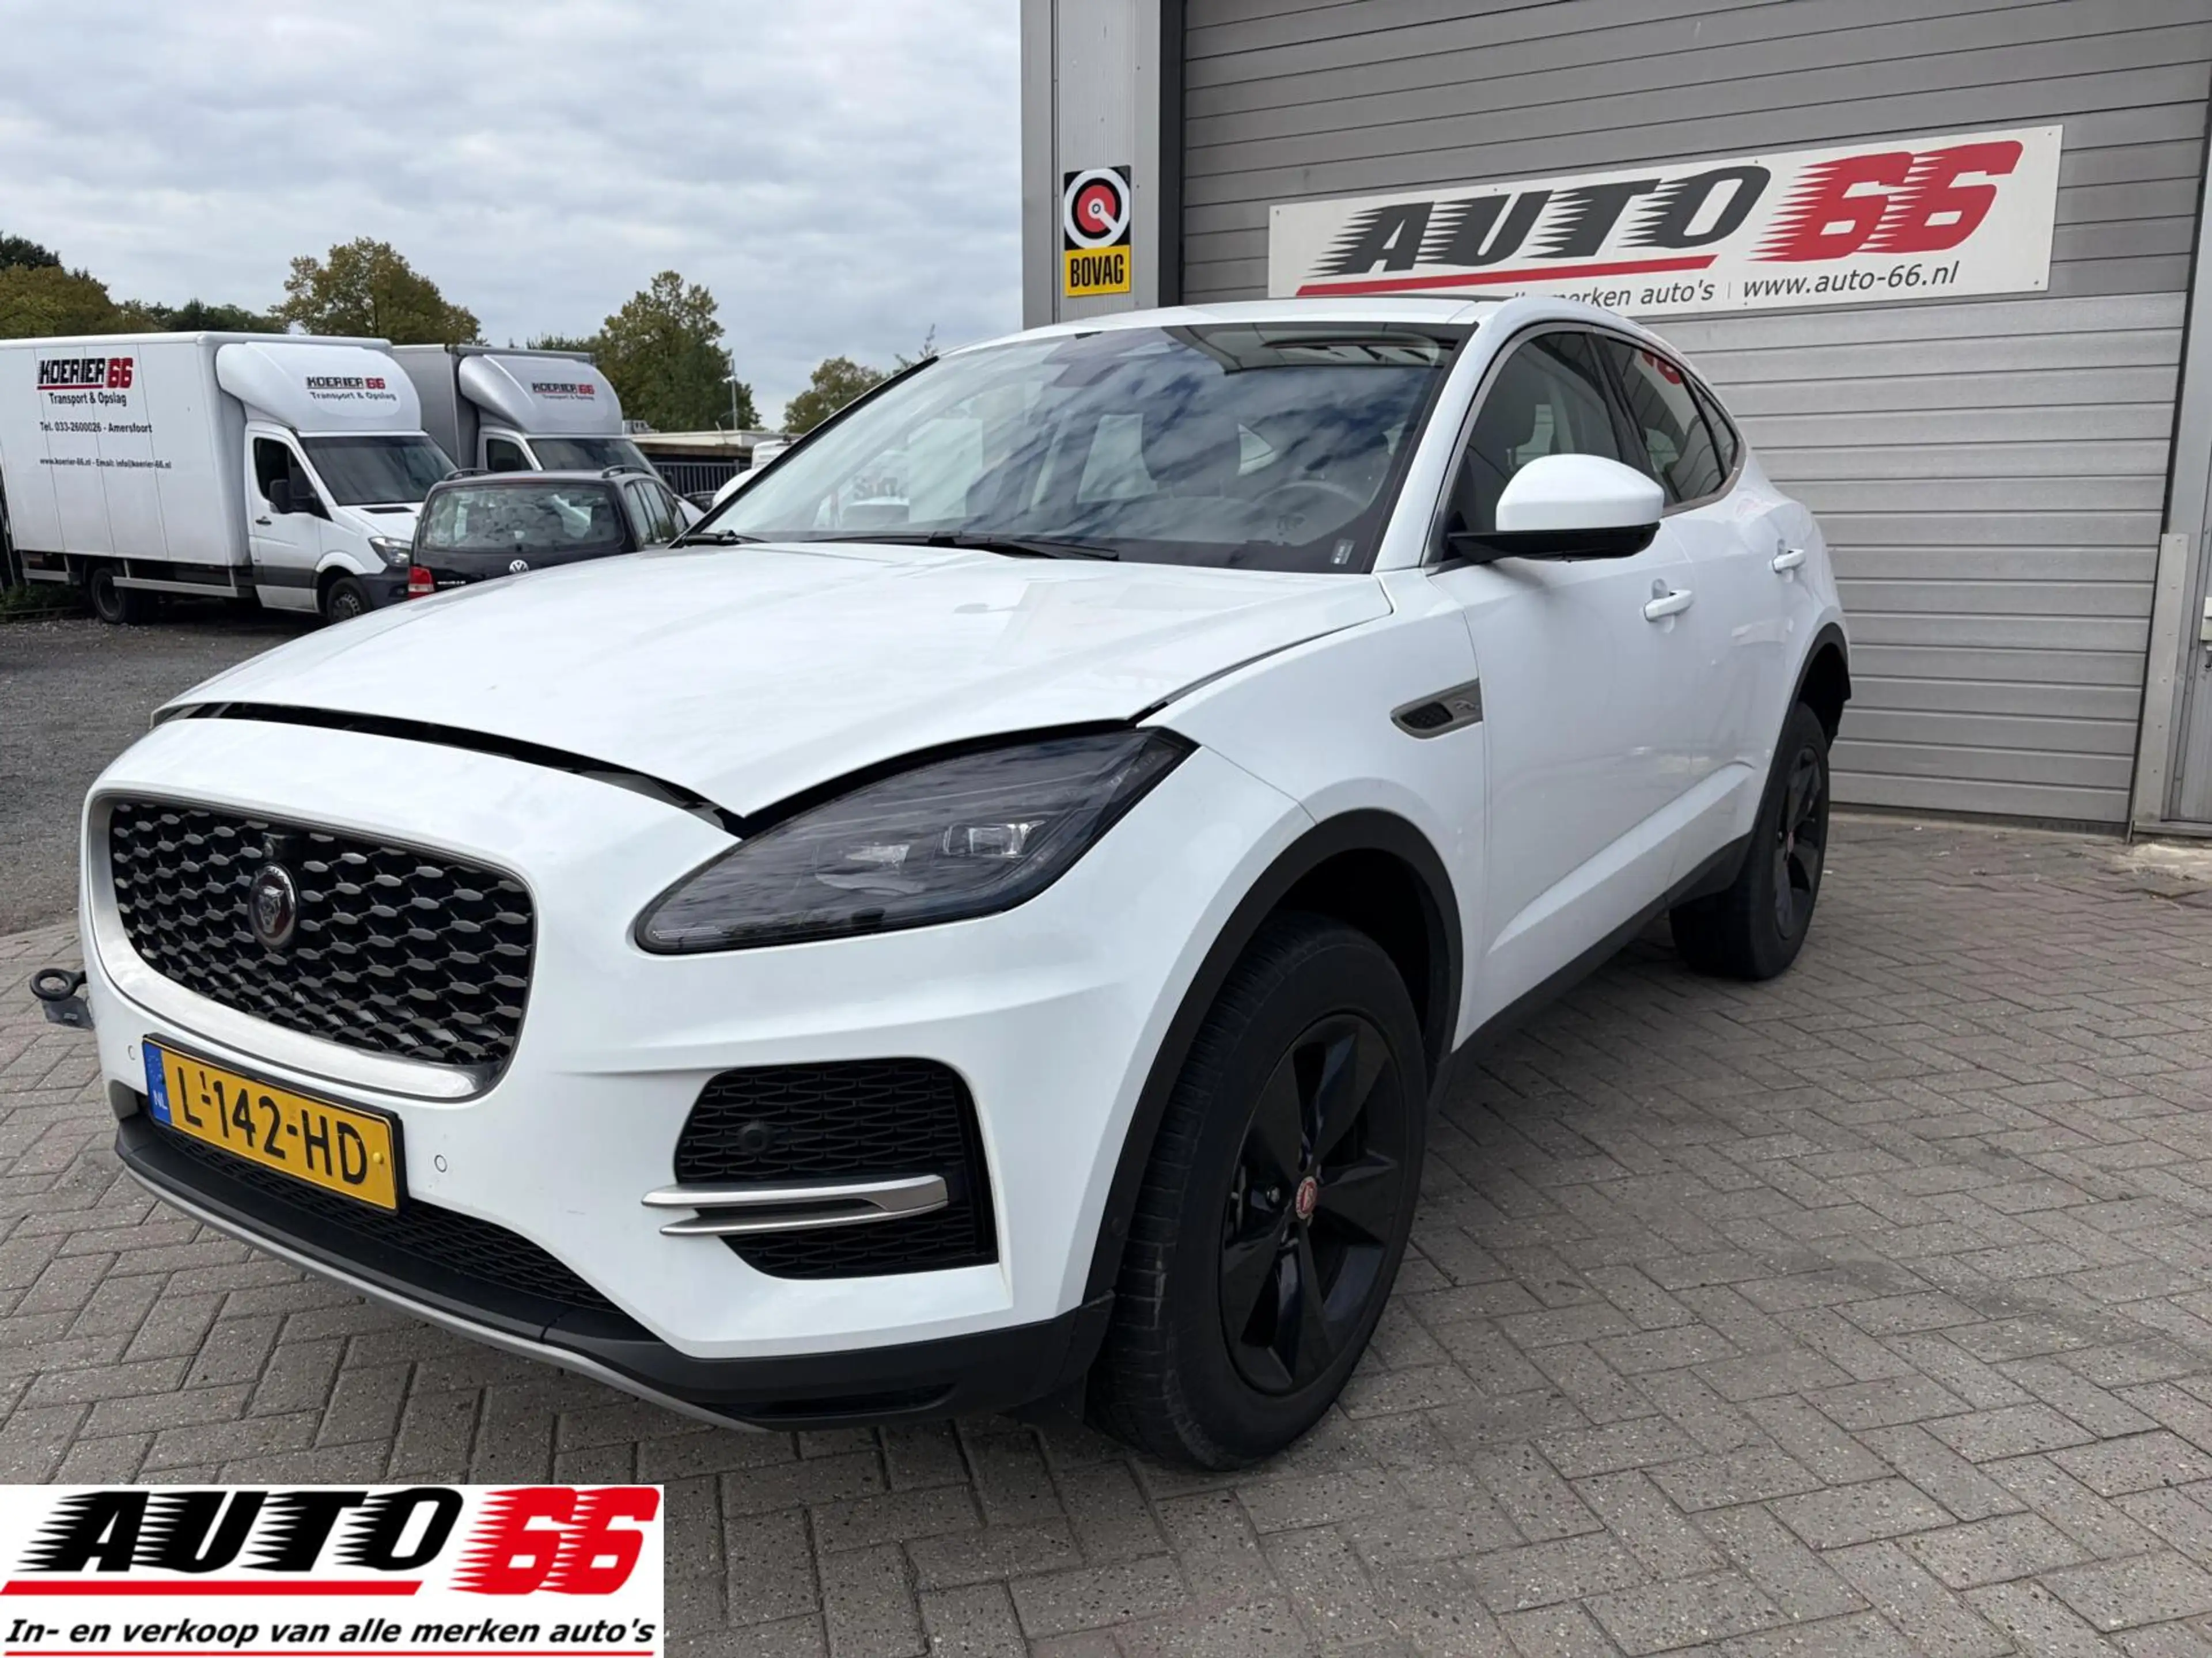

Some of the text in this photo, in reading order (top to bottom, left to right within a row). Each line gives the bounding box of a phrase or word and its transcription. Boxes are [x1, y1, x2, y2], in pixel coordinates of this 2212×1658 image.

[1303, 140, 2024, 278] AUTO 66
[1070, 254, 1124, 287] BOVAG
[1743, 260, 1960, 298] www.auto-66.nl
[1640, 280, 1715, 305] auto's
[37, 357, 134, 388] KOERIER 66
[306, 376, 386, 389] KOERIER 66
[48, 392, 127, 407] Transport & Opslag
[40, 422, 53, 431] Tel.
[108, 422, 152, 433] Amersfoort
[153, 1090, 168, 1110] NL
[177, 1066, 368, 1185] L-142-HD
